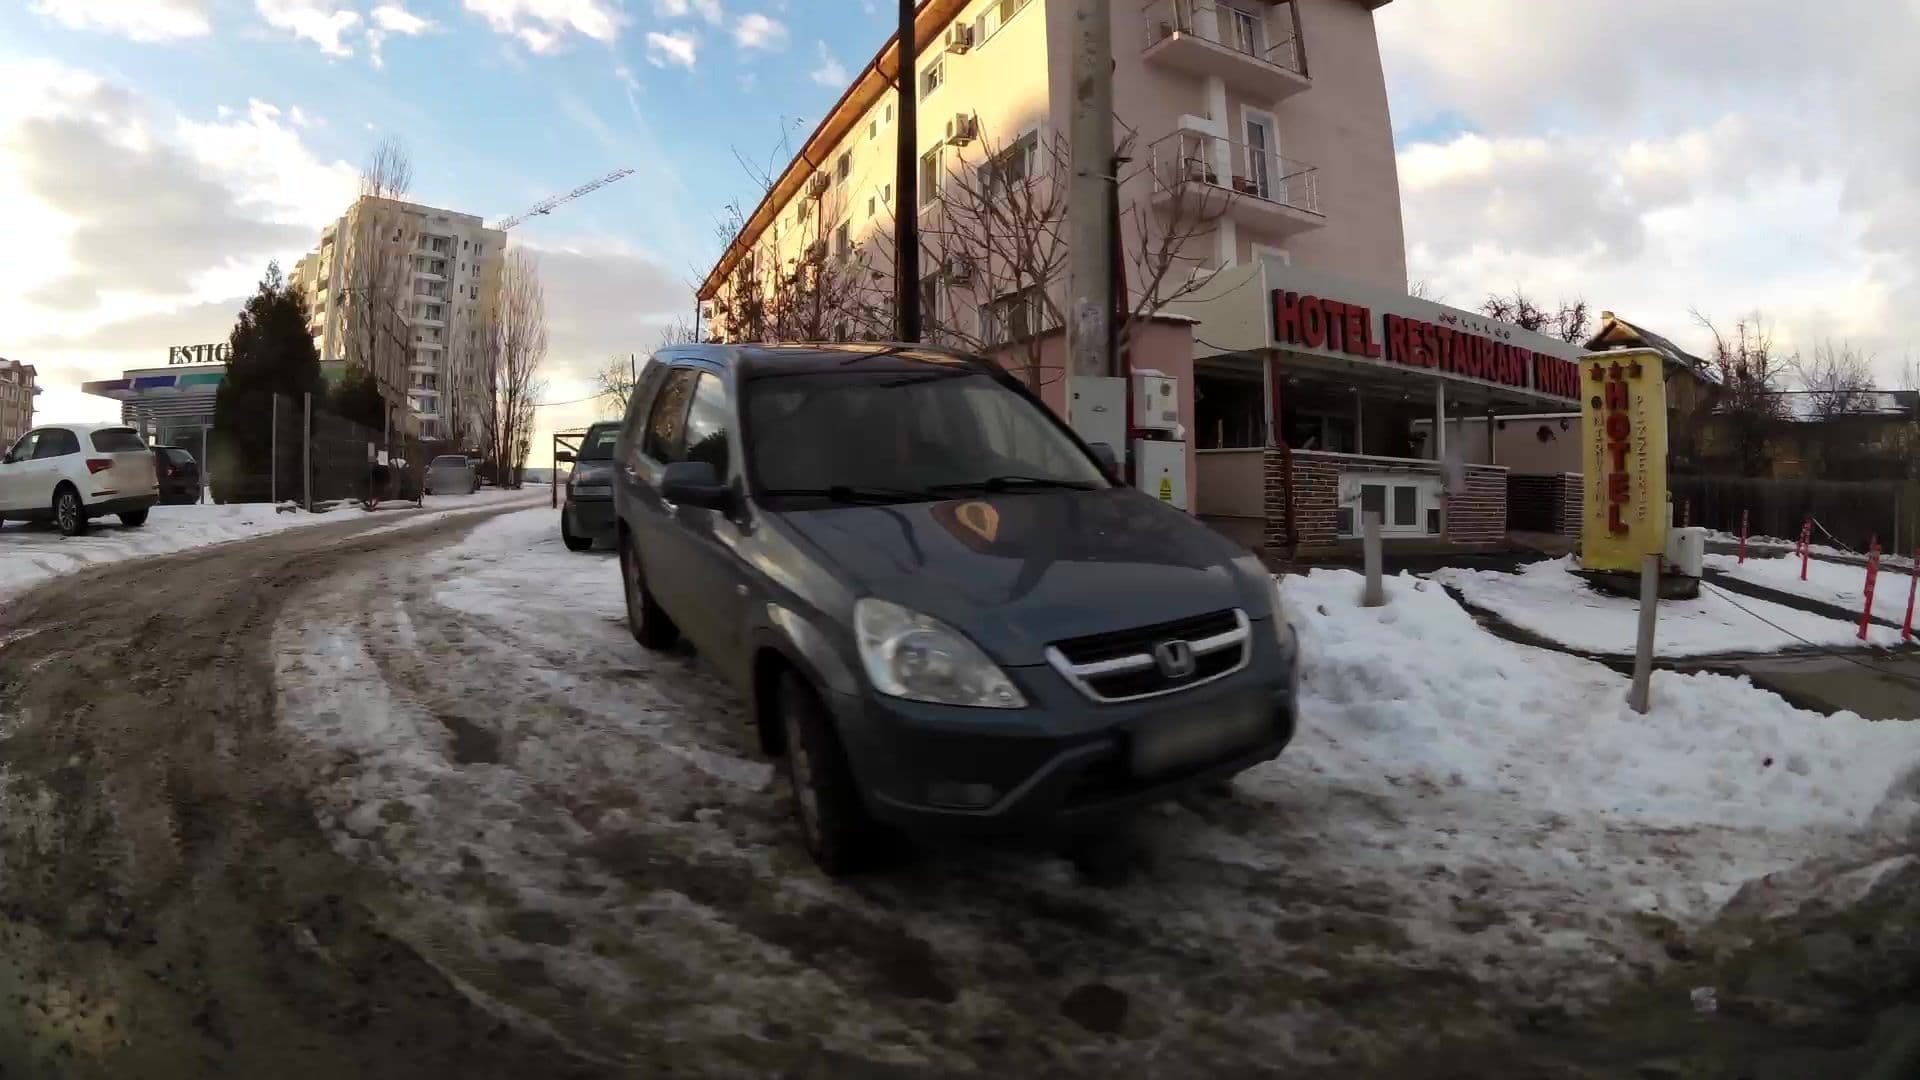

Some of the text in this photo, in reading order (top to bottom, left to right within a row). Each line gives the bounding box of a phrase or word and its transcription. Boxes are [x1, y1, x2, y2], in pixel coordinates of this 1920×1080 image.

[1271, 288, 1381, 358] HOTEL
[1384, 313, 1531, 387] RESTAURANT
[1605, 381, 1631, 535] HOTEL
